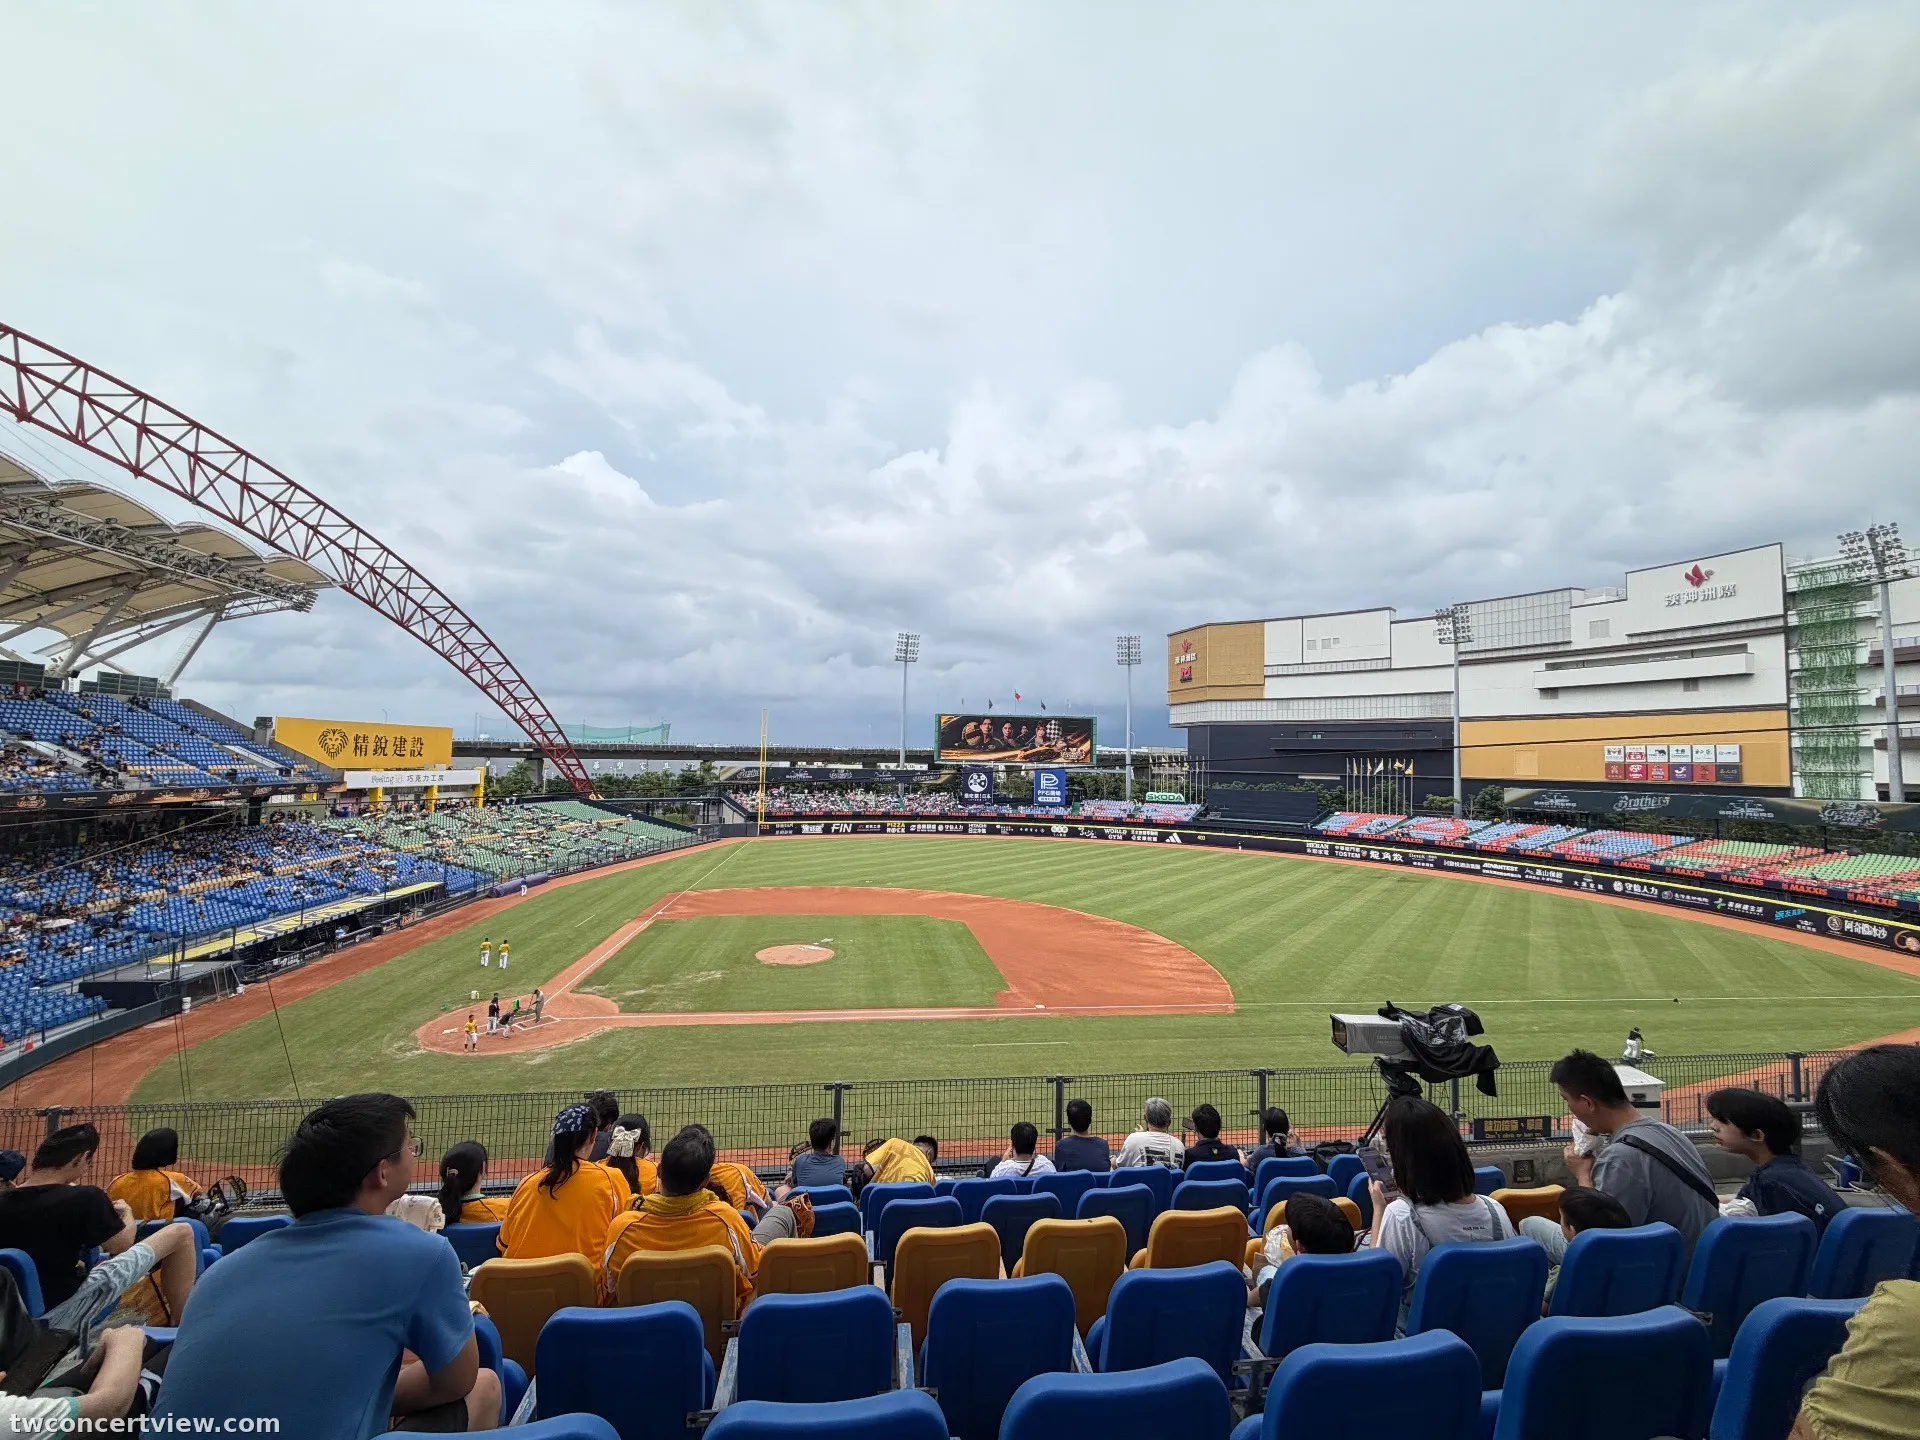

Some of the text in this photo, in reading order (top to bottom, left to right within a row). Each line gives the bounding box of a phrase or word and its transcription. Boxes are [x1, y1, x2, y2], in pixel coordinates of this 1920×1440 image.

[353, 734, 425, 758] 精銳建設
[831, 823, 853, 833] FIN
[1440, 840, 1464, 848] MAXXIS
[1480, 845, 1507, 853] MAXXIS
[1334, 850, 1361, 859] TOSTEM
[1525, 849, 1552, 858] MAXXIS
[1571, 855, 1599, 864] MAXXIS
[1482, 862, 1519, 872] ADVANTEST
[1620, 861, 1651, 871] MAXXIS
[1672, 868, 1705, 878] MAXXIS
[1728, 875, 1764, 886] MAXXIS
[1624, 882, 1659, 896] 守信人力
[1790, 882, 1828, 896] MAXXIS
[1856, 893, 1898, 908] MAXXIS
